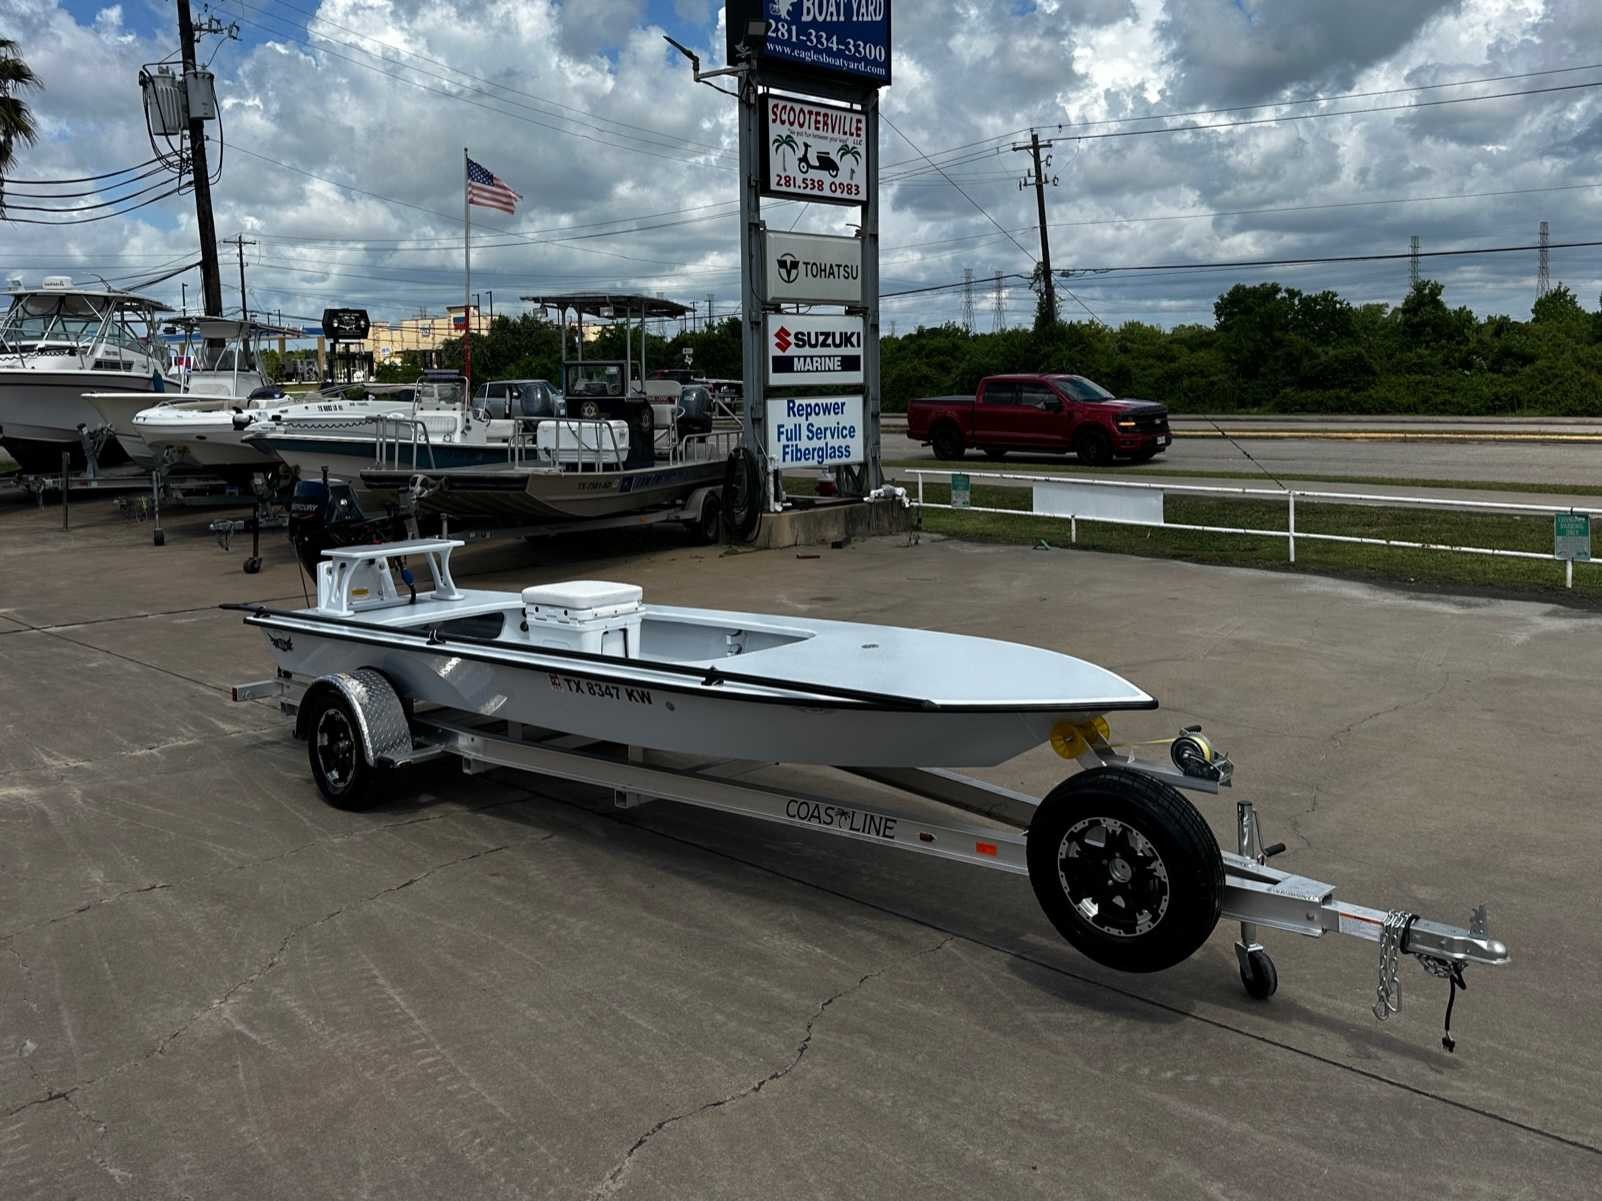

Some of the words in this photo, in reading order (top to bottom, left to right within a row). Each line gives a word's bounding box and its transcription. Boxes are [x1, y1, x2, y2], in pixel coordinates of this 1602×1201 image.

[801, 0, 848, 22] BOAT
[852, 0, 884, 22] YARD
[767, 19, 886, 63] 281-334-3300
[766, 42, 886, 76] www.eaglesboatyard.com
[771, 103, 862, 137] SCOOTERVILLE
[776, 174, 824, 192] 281.538
[829, 181, 861, 196] 0983
[802, 261, 859, 280] TOHATSU
[793, 331, 862, 348] SUZUKI
[793, 356, 842, 371] MARINE
[786, 399, 846, 421] Repower
[777, 423, 802, 442] Full
[806, 422, 856, 441] Service
[782, 442, 851, 465] Fiberglass
[564, 679, 585, 694] TX
[586, 681, 621, 701] 8347
[624, 687, 653, 705] KW
